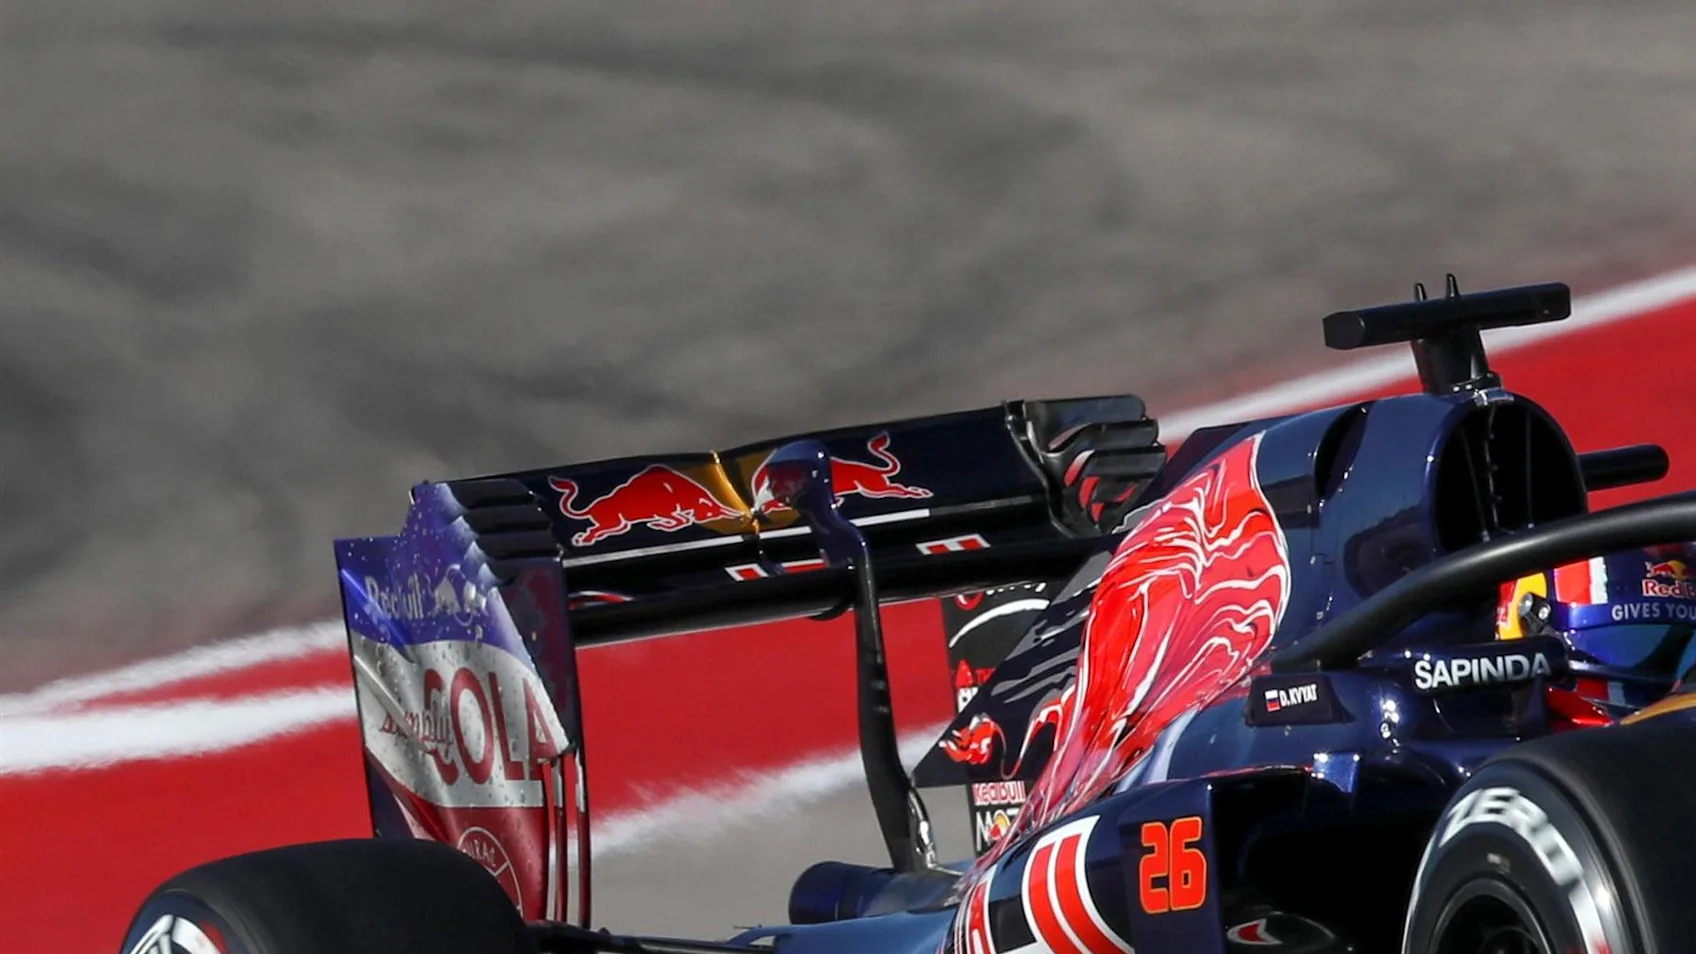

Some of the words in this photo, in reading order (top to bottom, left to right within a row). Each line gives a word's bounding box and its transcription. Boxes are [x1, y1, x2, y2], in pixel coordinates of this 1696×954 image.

[1611, 602, 1661, 622] GIVES
[1414, 652, 1551, 692] SAPINDA
[422, 666, 560, 786] COLA
[1139, 816, 1207, 914] 26
